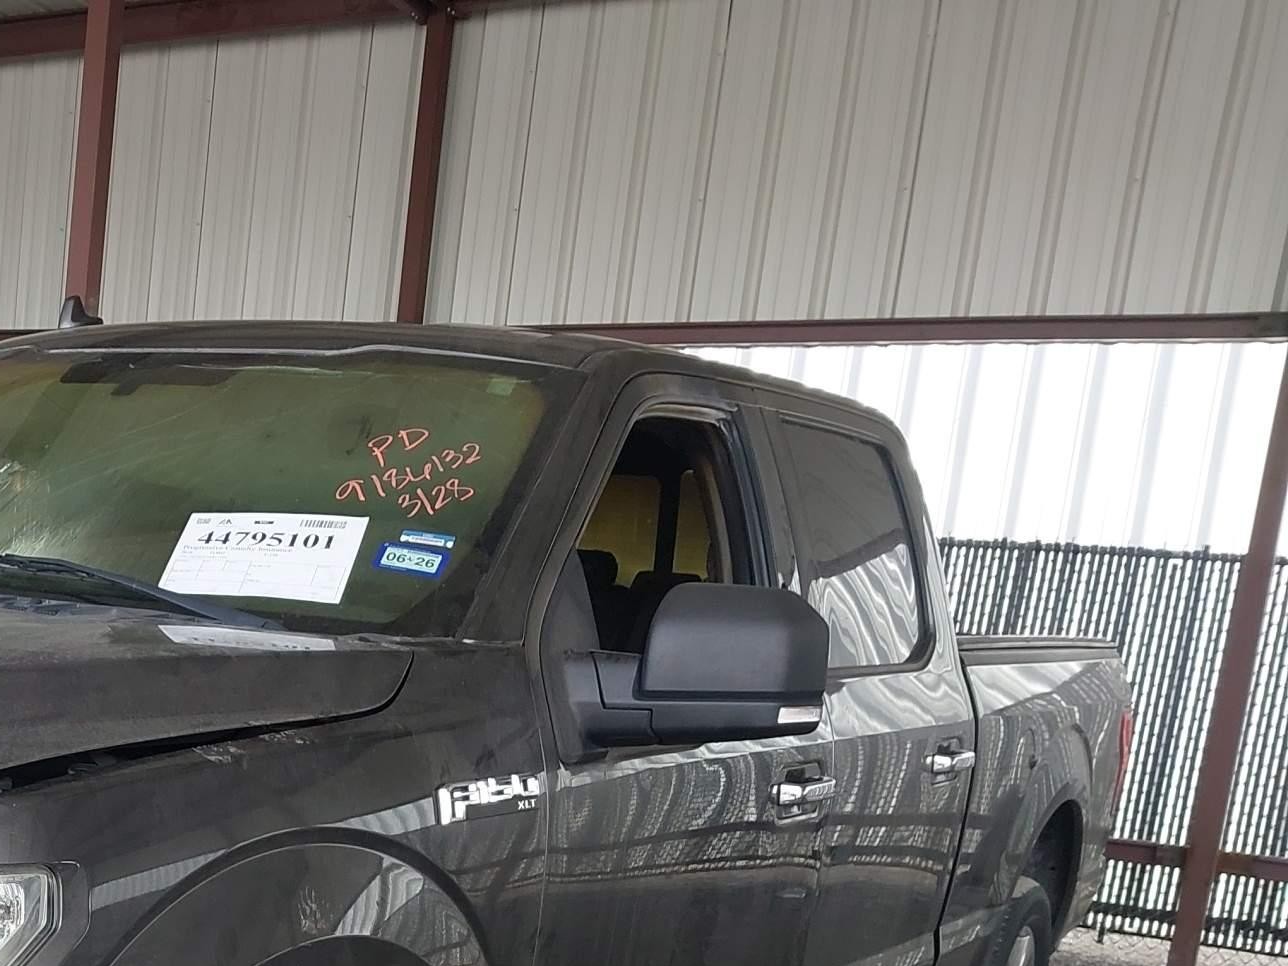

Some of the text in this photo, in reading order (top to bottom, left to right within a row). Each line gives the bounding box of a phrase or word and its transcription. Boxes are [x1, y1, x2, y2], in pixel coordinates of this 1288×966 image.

[368, 428, 429, 467] PD
[197, 531, 334, 550] 44795101
[517, 799, 537, 810] XLT
